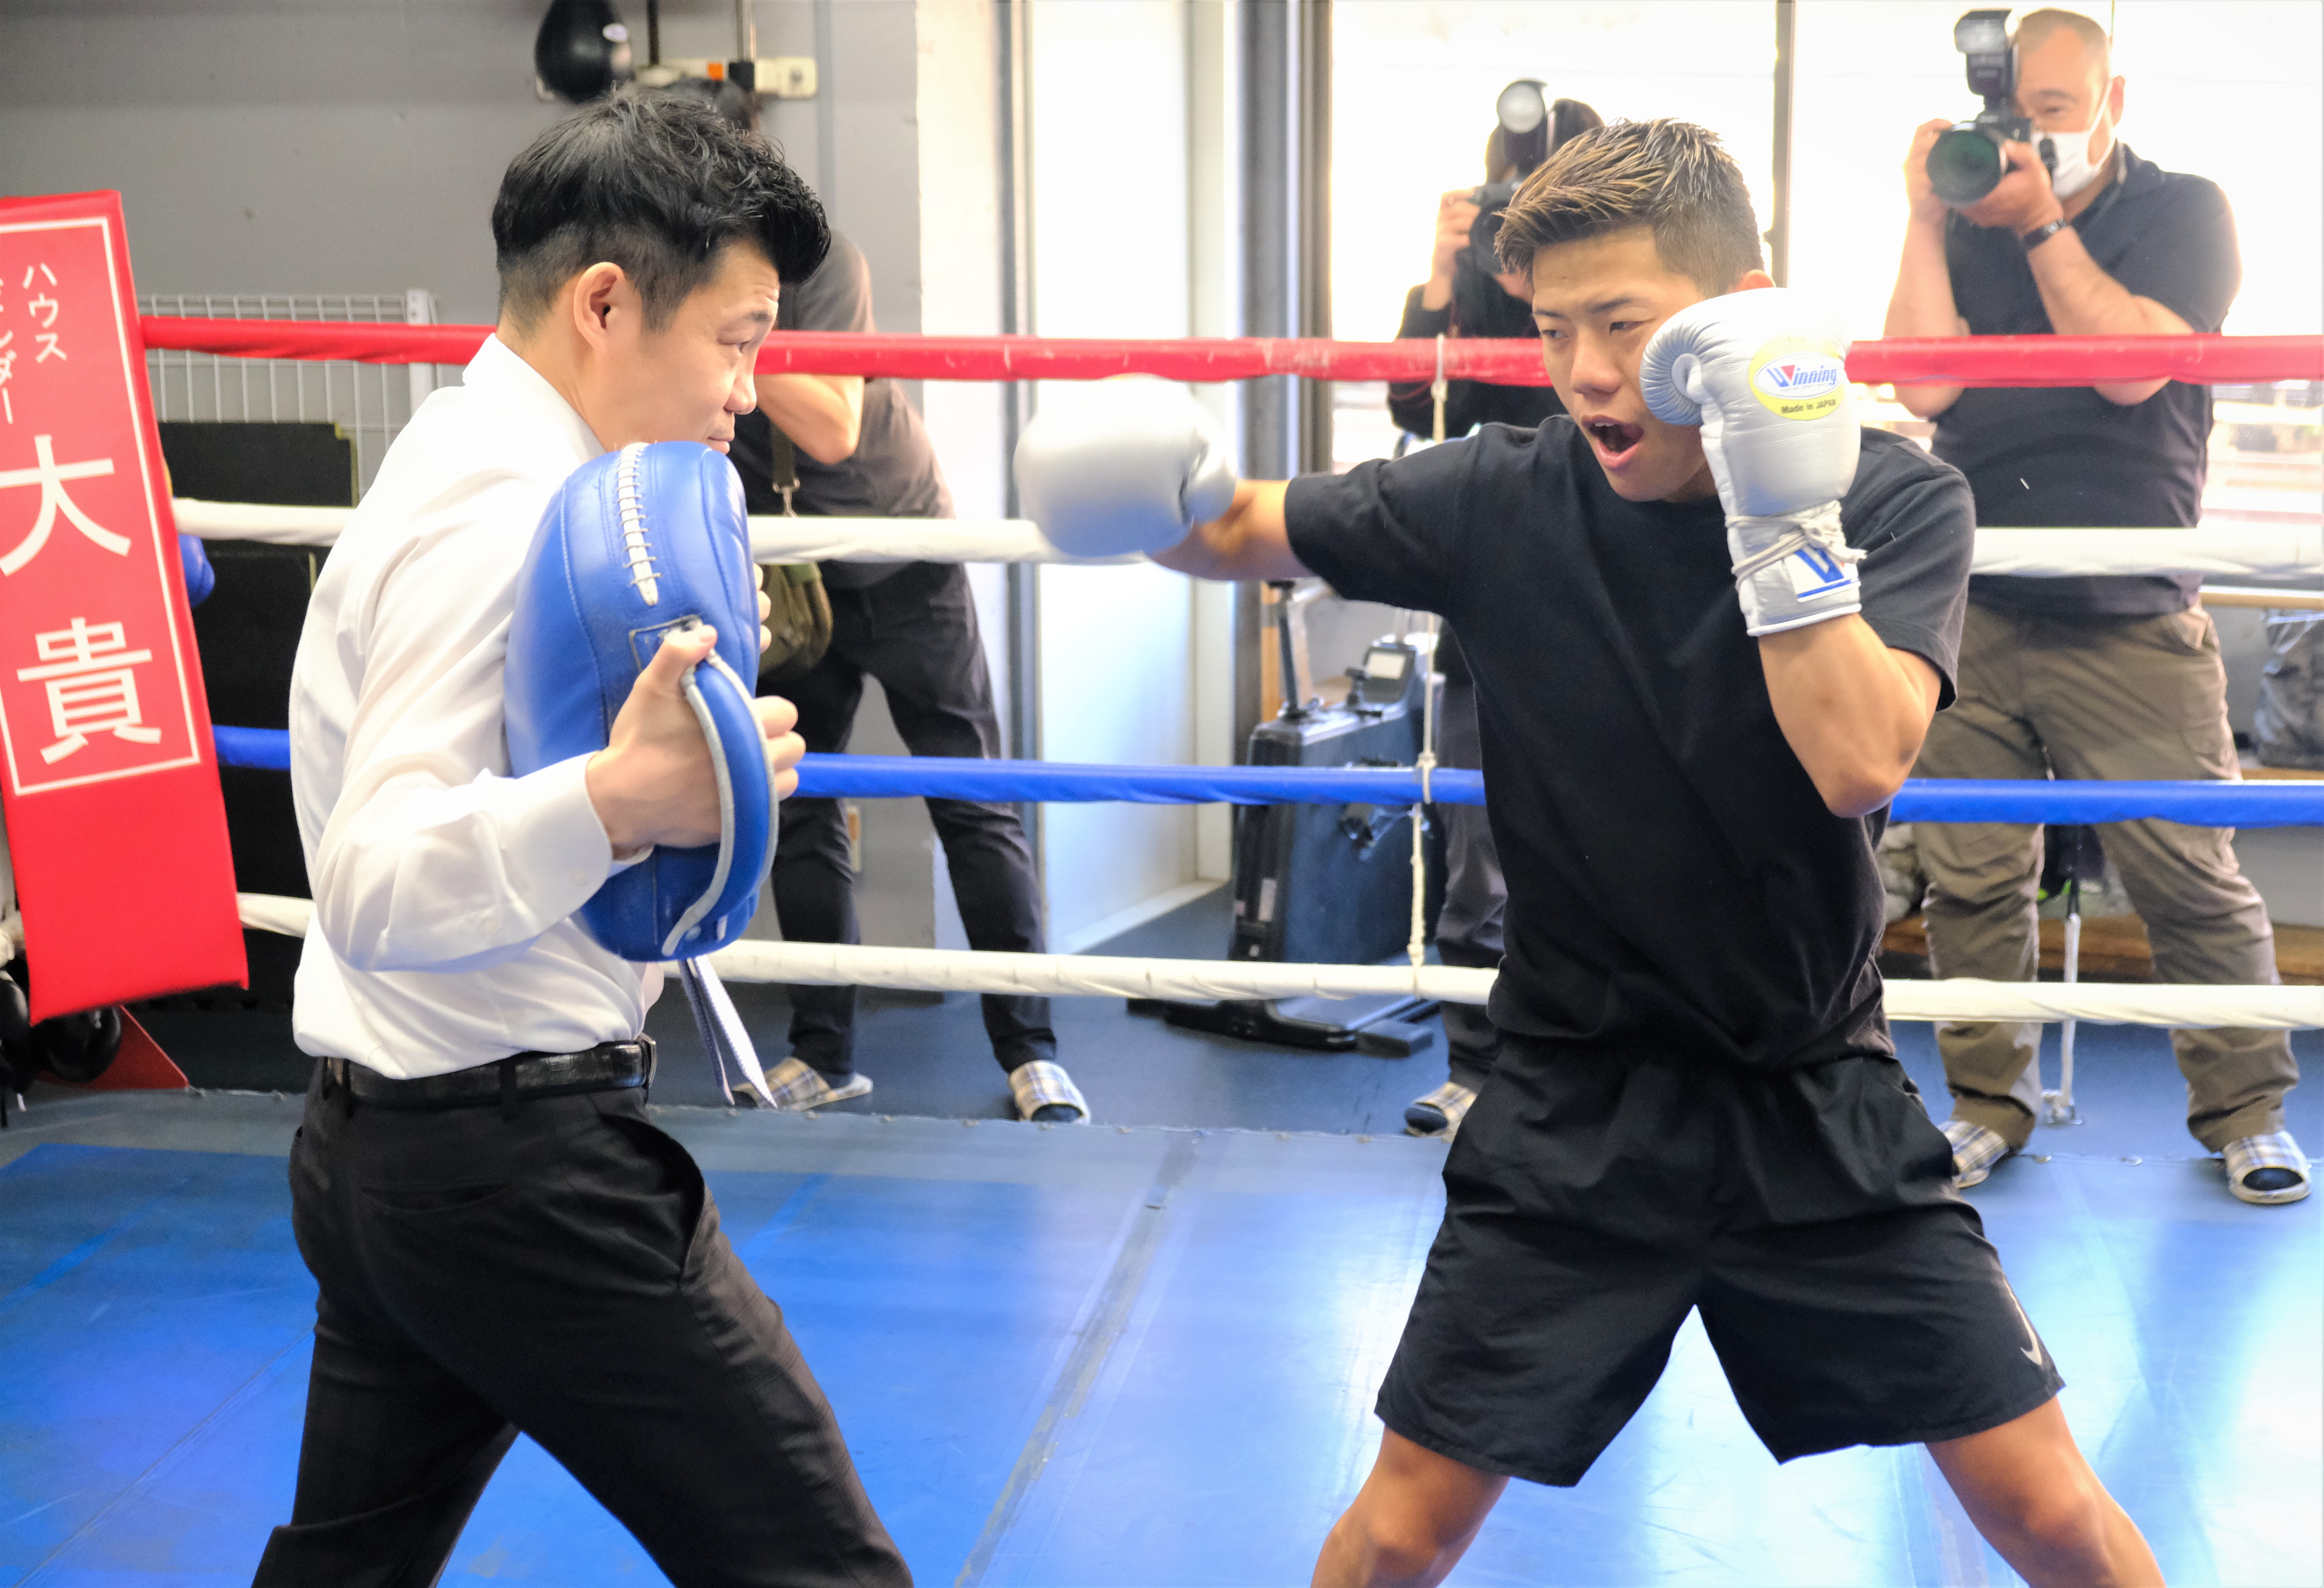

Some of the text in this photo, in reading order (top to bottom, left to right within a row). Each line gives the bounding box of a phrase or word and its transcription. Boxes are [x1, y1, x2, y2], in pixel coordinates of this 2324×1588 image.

[22, 262, 67, 364] ハウス
[1766, 365, 1837, 387] Winning
[1781, 404, 1804, 414] Made
[1816, 399, 1836, 409] JAPAN
[0, 435, 161, 765] 大貴
